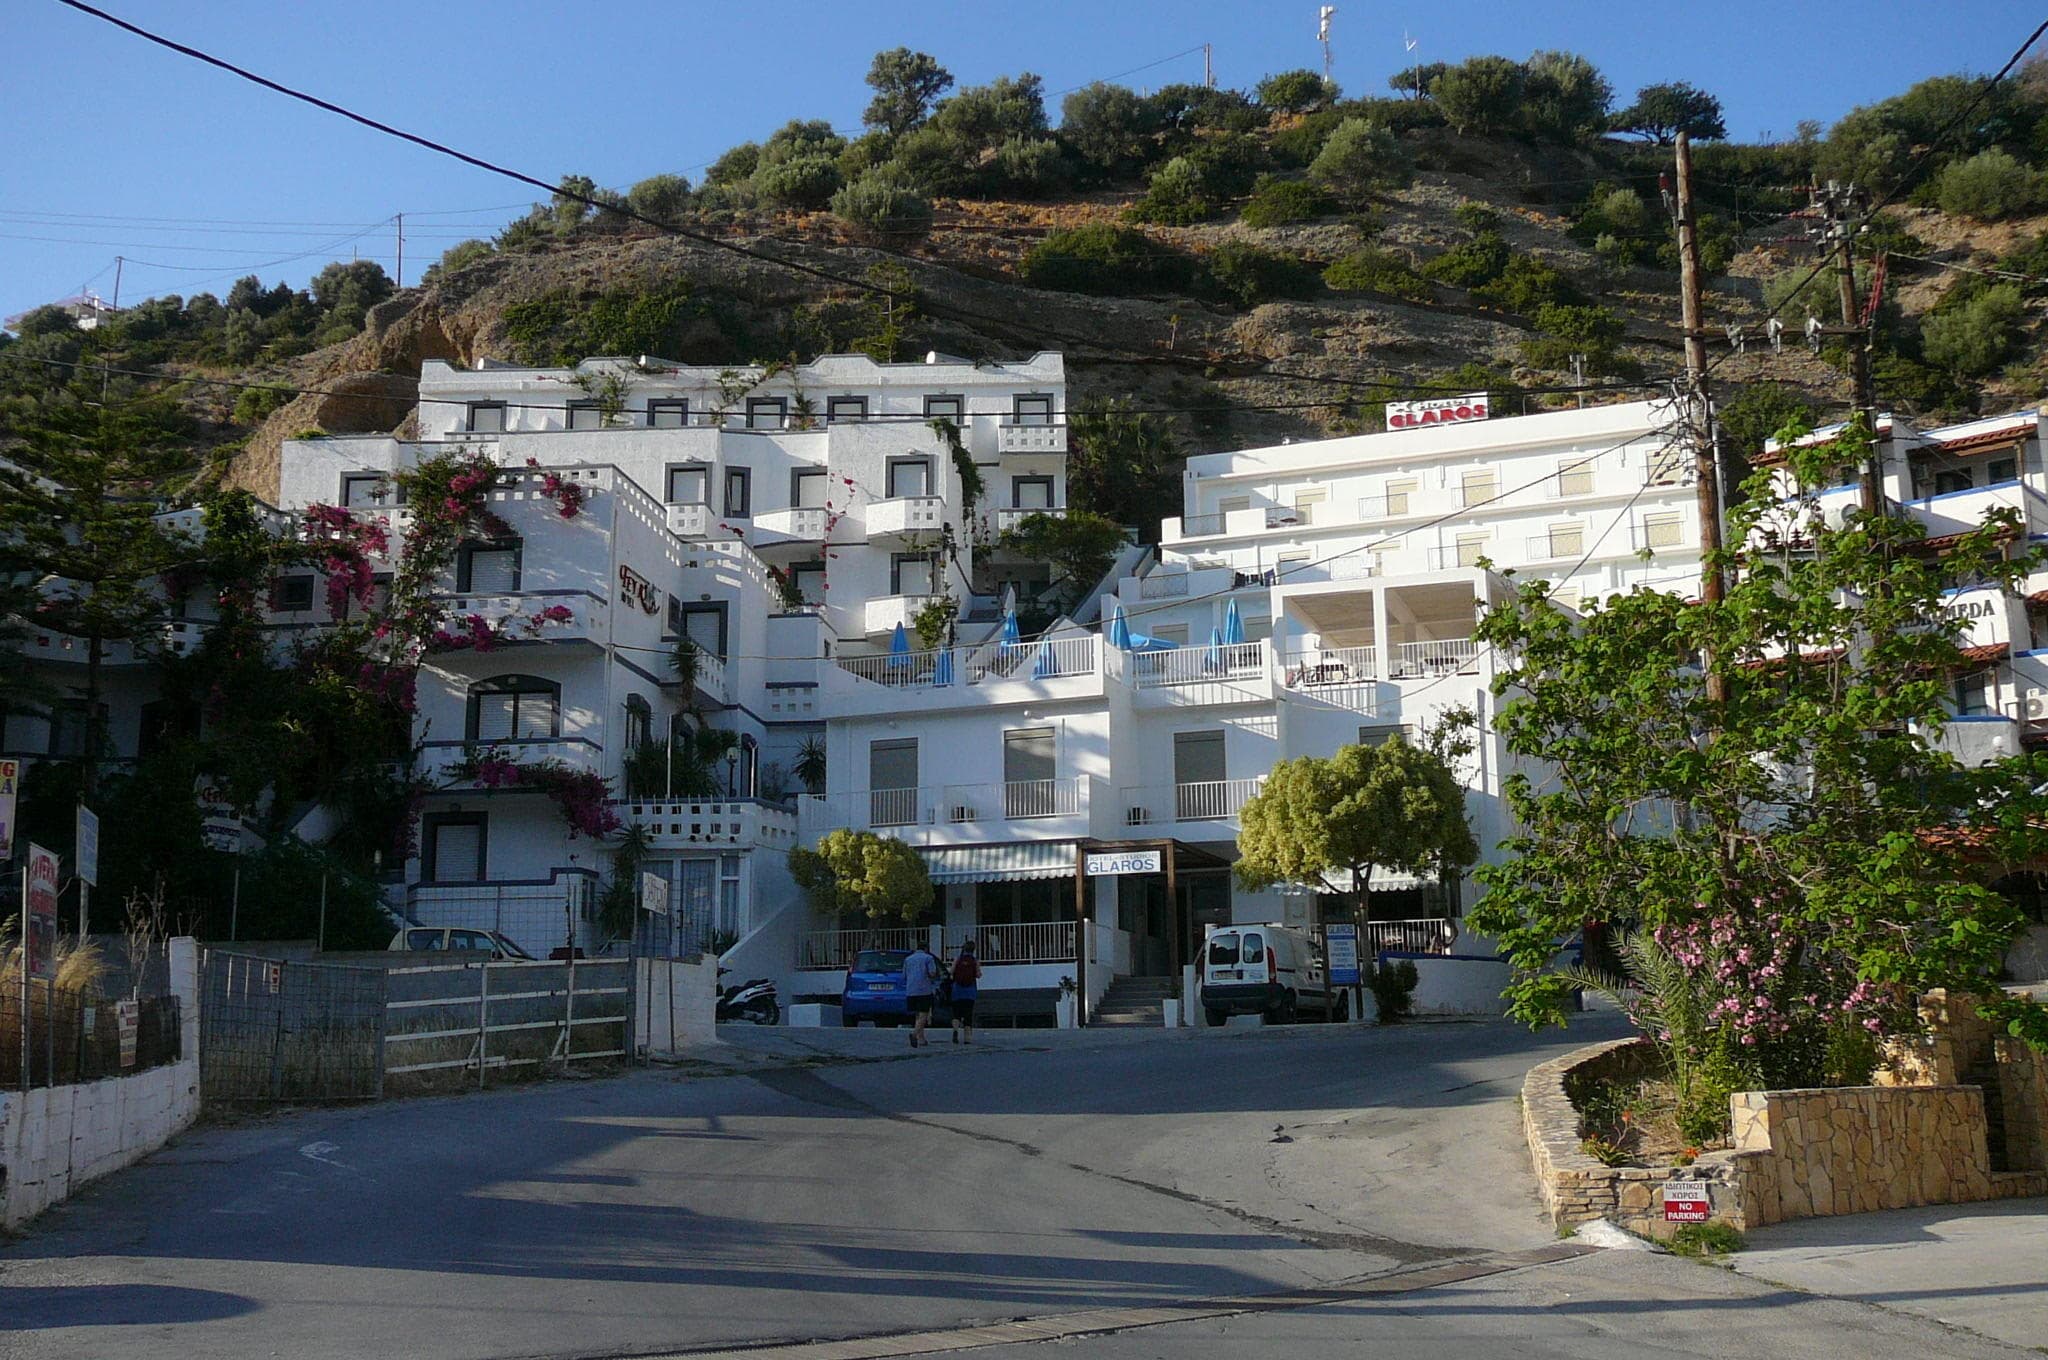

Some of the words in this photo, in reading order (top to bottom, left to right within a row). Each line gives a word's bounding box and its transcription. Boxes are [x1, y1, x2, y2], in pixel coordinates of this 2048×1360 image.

[1389, 404, 1487, 427] GLAROS
[1088, 858, 1155, 873] GLAROS
[1678, 1202, 1693, 1211] NO
[1667, 1211, 1705, 1220] PARKING
